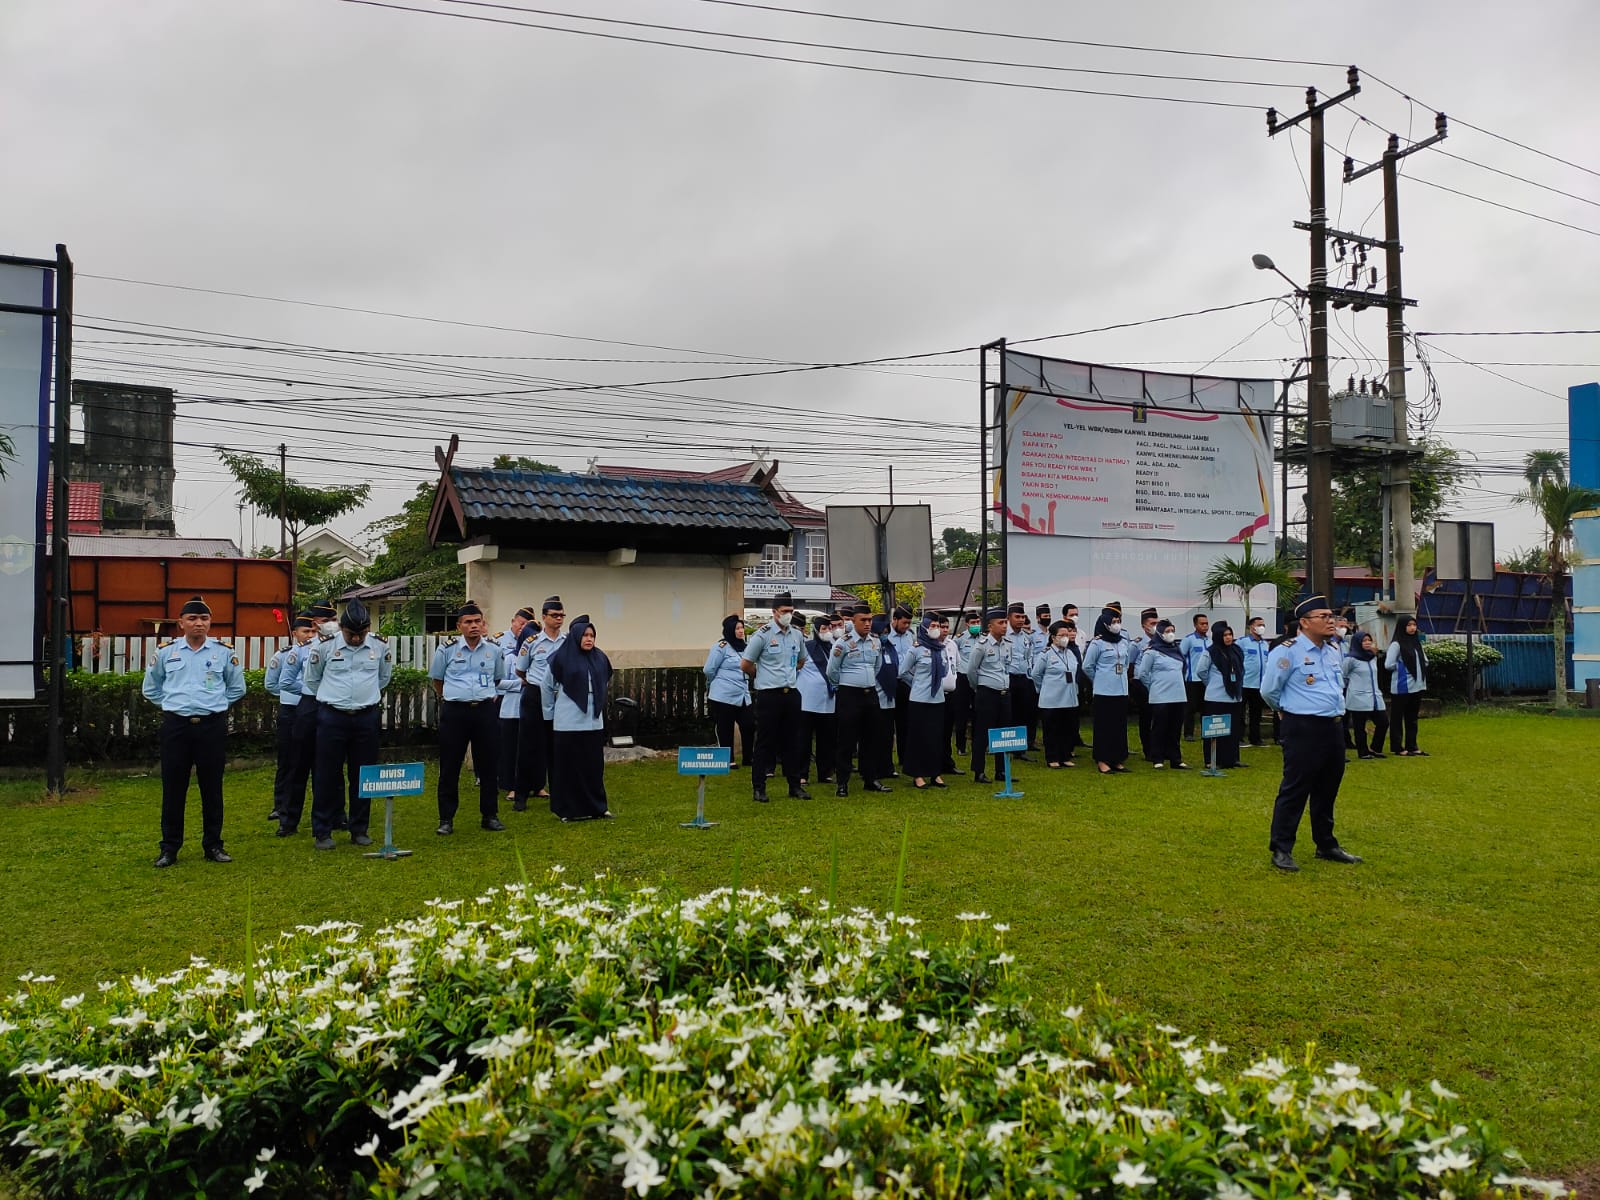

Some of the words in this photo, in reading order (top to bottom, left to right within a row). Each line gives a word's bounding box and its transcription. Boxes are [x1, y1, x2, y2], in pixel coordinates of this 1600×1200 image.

[1063, 423, 1086, 431] YEL-YEL
[1088, 425, 1123, 434] WBK/WBBM
[1148, 431, 1192, 440] KEMENKUMHAM
[1022, 450, 1046, 458] ADAKAH
[1065, 454, 1096, 462] INTEGRITAS
[1158, 452, 1199, 460] KEMENKUMHAM
[1046, 493, 1091, 501] KEMENKUMHAM
[380, 768, 406, 779] DIVISI
[362, 779, 421, 792] KEIMIGRASIAN
